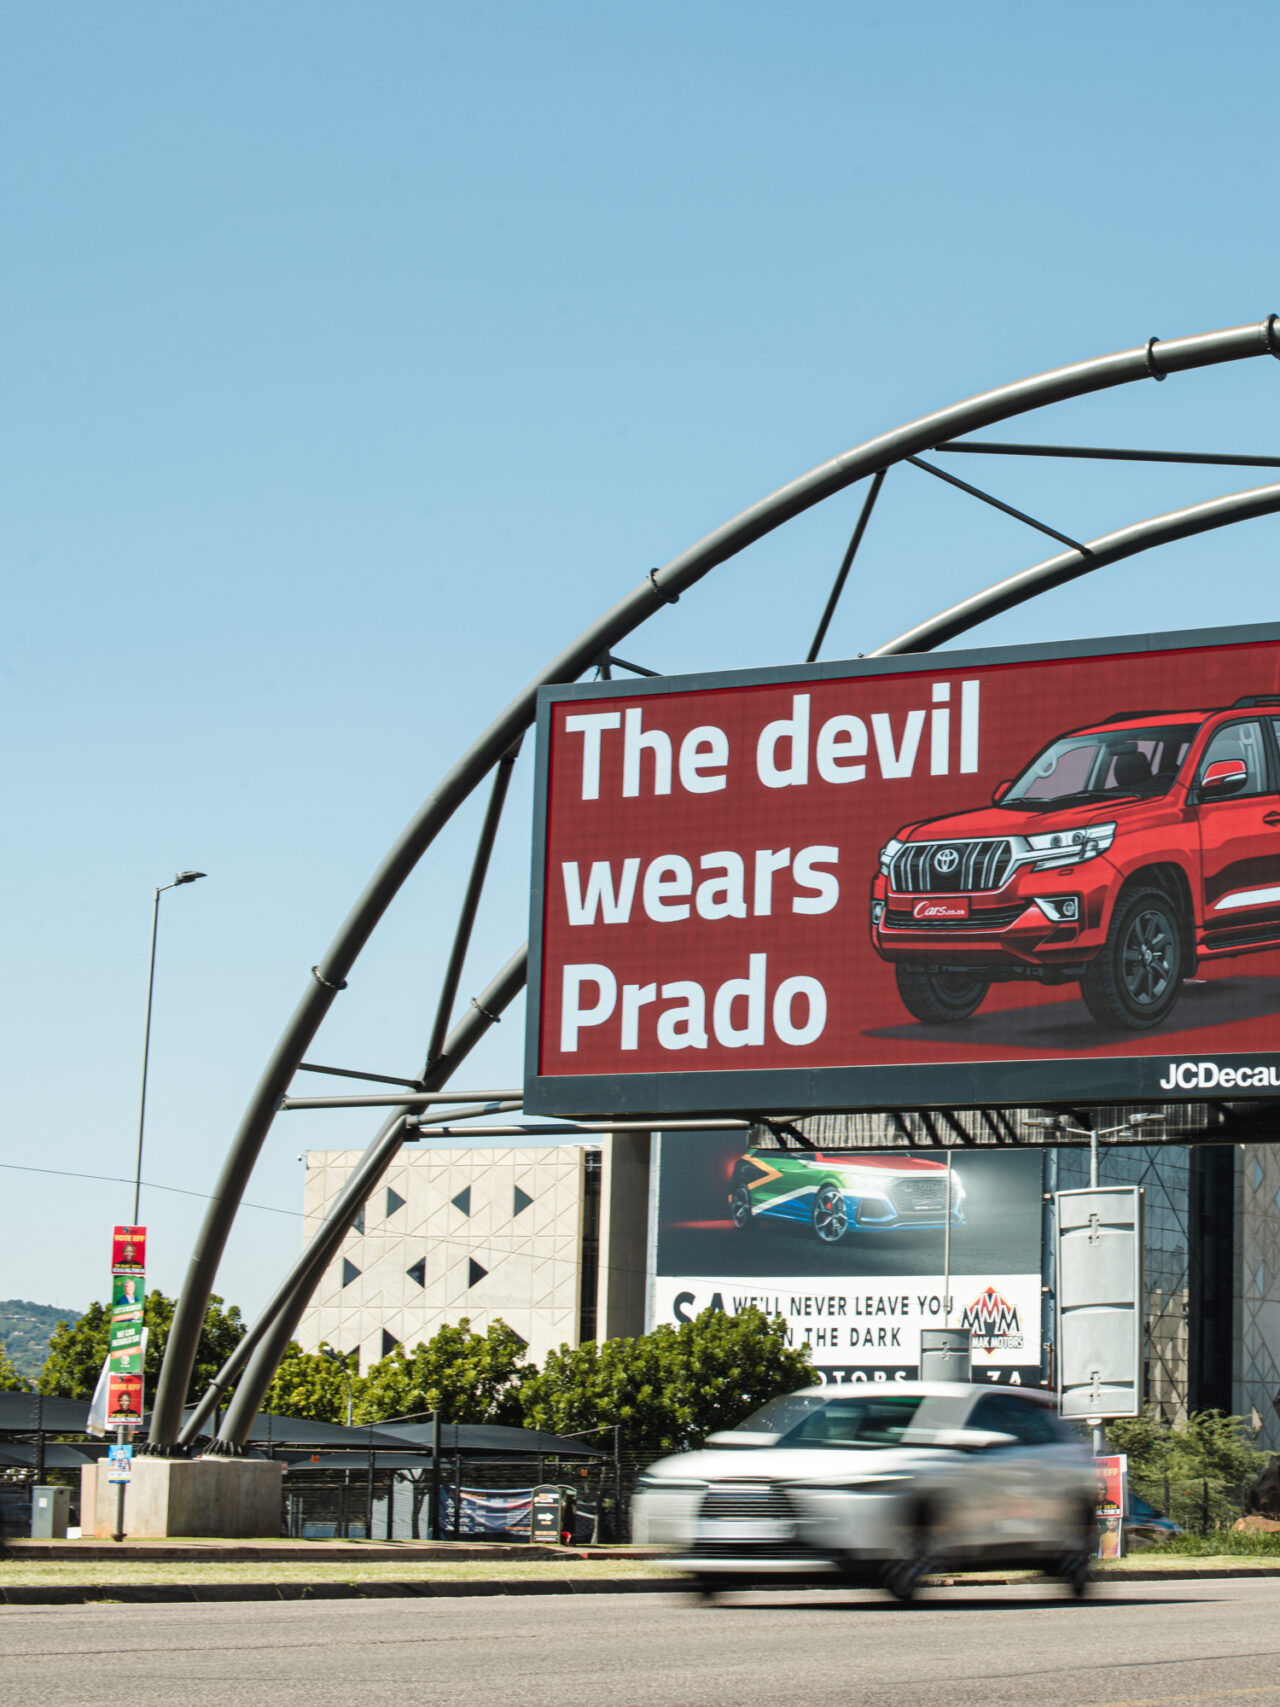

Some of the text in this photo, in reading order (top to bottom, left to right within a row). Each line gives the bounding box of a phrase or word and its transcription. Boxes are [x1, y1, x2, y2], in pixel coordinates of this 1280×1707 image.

[565, 679, 980, 801] The devil
[561, 844, 840, 926] wears
[559, 952, 828, 1053] Prado
[791, 1296, 846, 1316] NEVER
[855, 1296, 909, 1315] LEAVE
[917, 1295, 954, 1315] YOU
[804, 1327, 838, 1346] THE
[850, 1327, 901, 1346] DARK
[991, 1335, 1024, 1349] MOTORS
